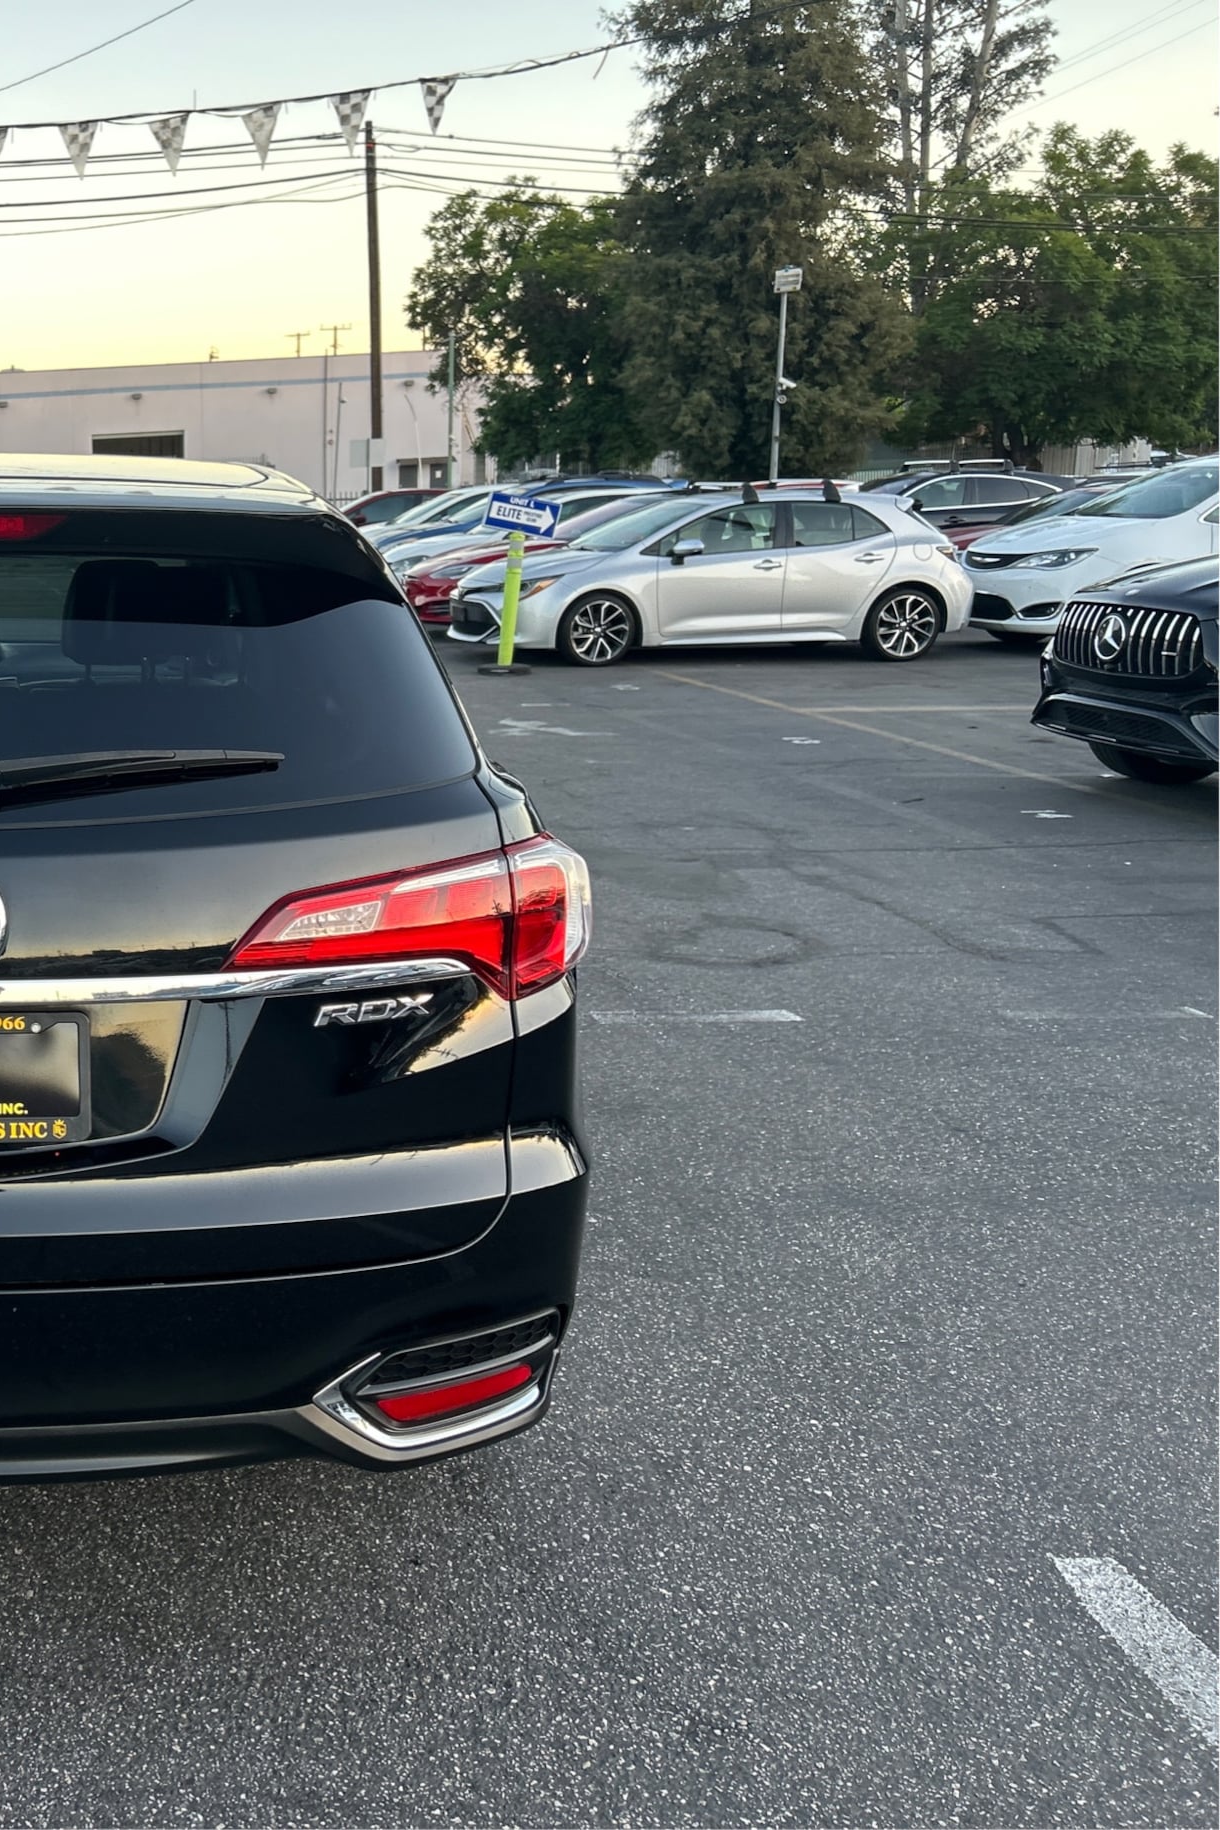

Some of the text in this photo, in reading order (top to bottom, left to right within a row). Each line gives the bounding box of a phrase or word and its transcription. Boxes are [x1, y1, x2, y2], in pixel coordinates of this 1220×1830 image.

[510, 496, 528, 506] UNIT
[497, 505, 522, 519] ELITE
[313, 993, 435, 1028] RDX
[9, 1121, 48, 1140] INC
